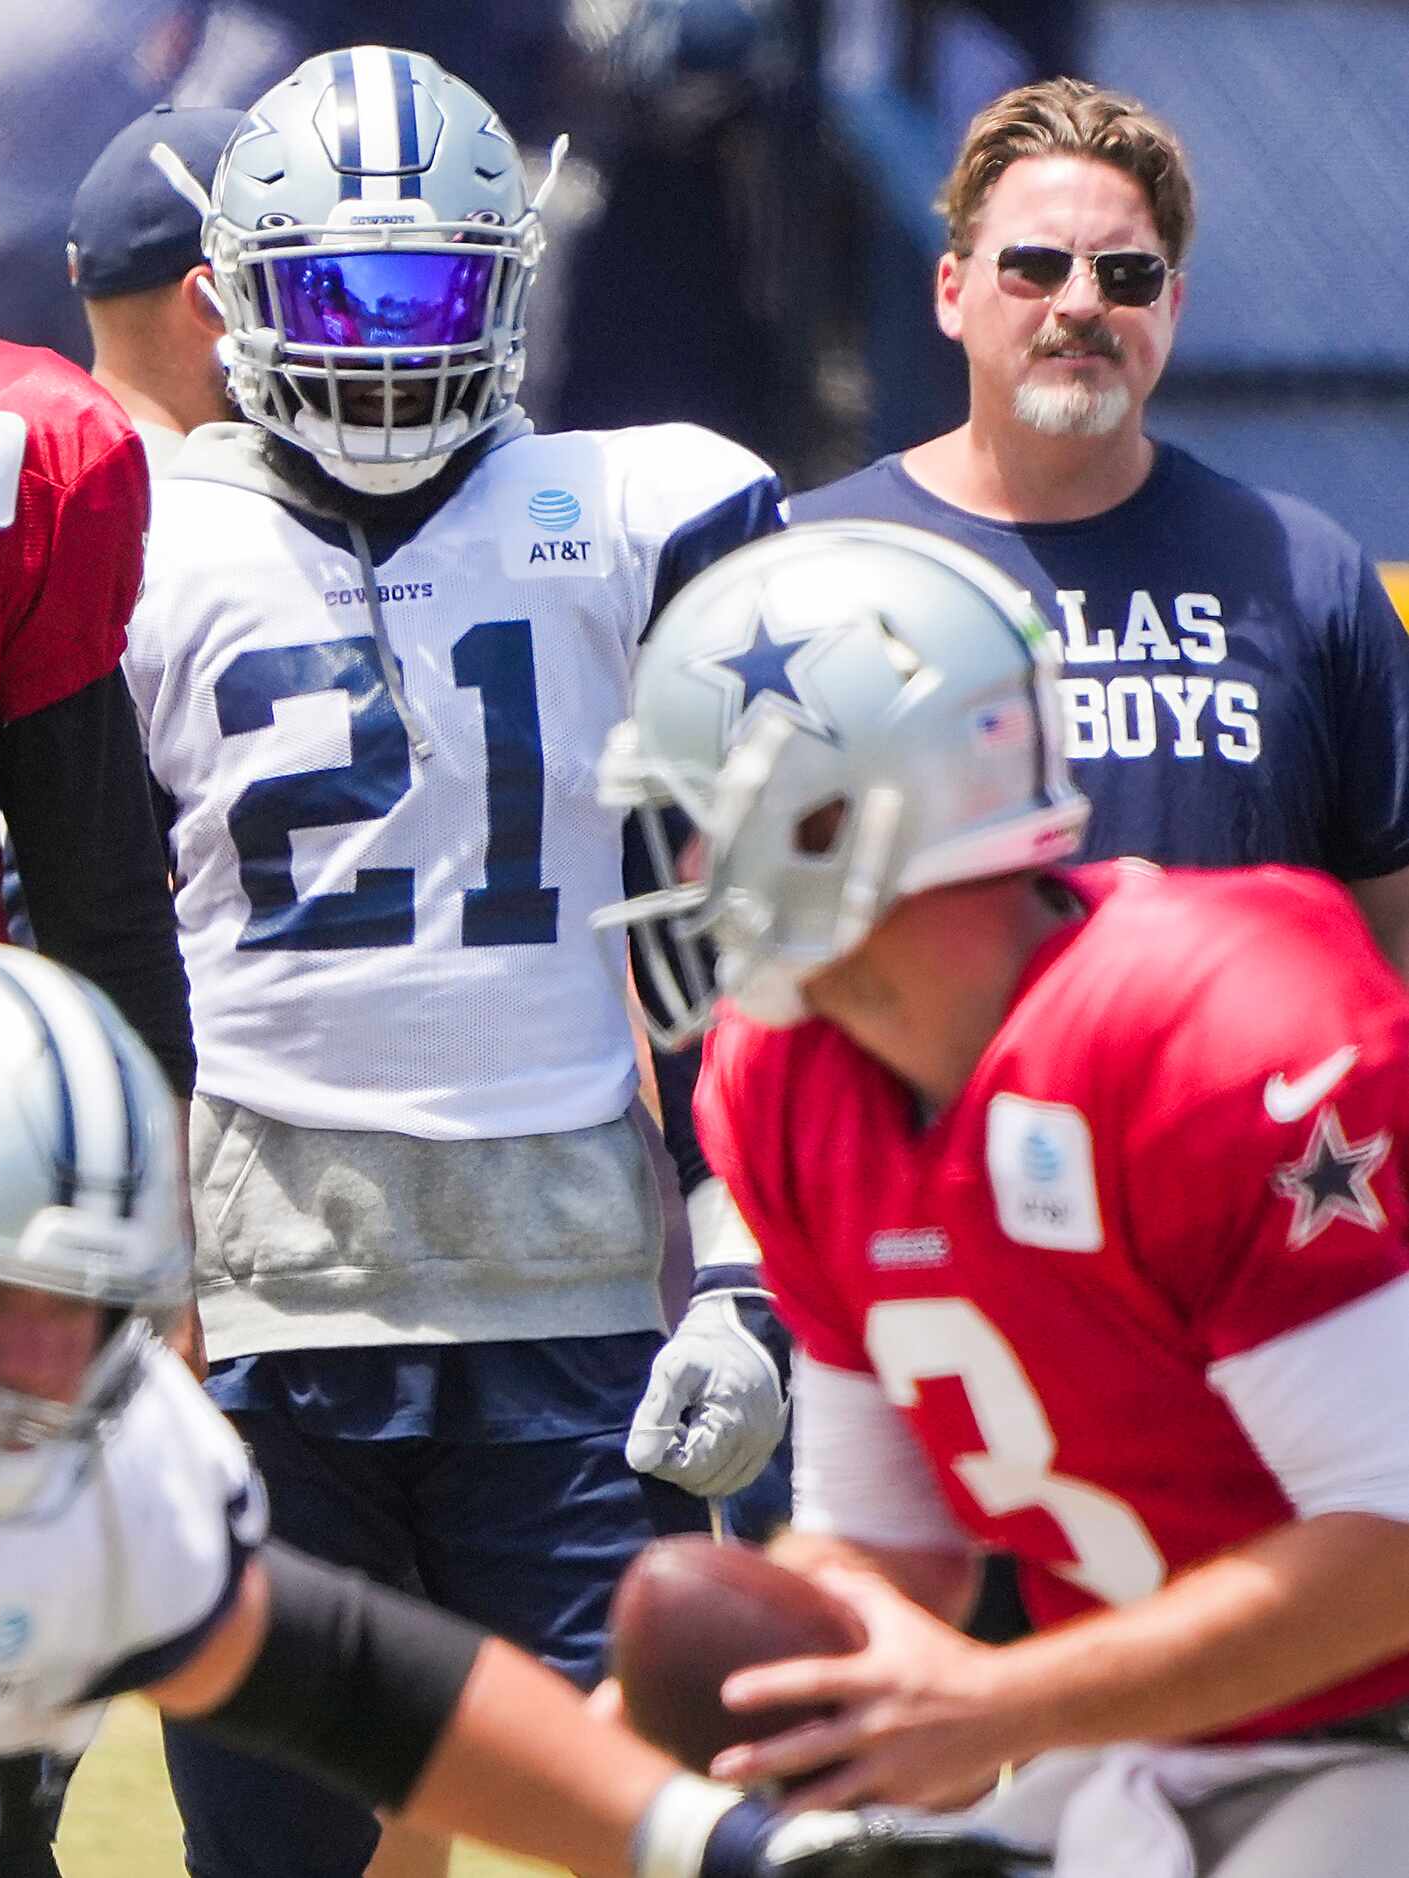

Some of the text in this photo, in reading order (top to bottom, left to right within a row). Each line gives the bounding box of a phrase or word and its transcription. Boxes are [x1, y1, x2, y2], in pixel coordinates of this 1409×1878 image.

[528, 540, 591, 564] AT&T
[213, 619, 559, 951] 21
[864, 1297, 1169, 1610] 3
